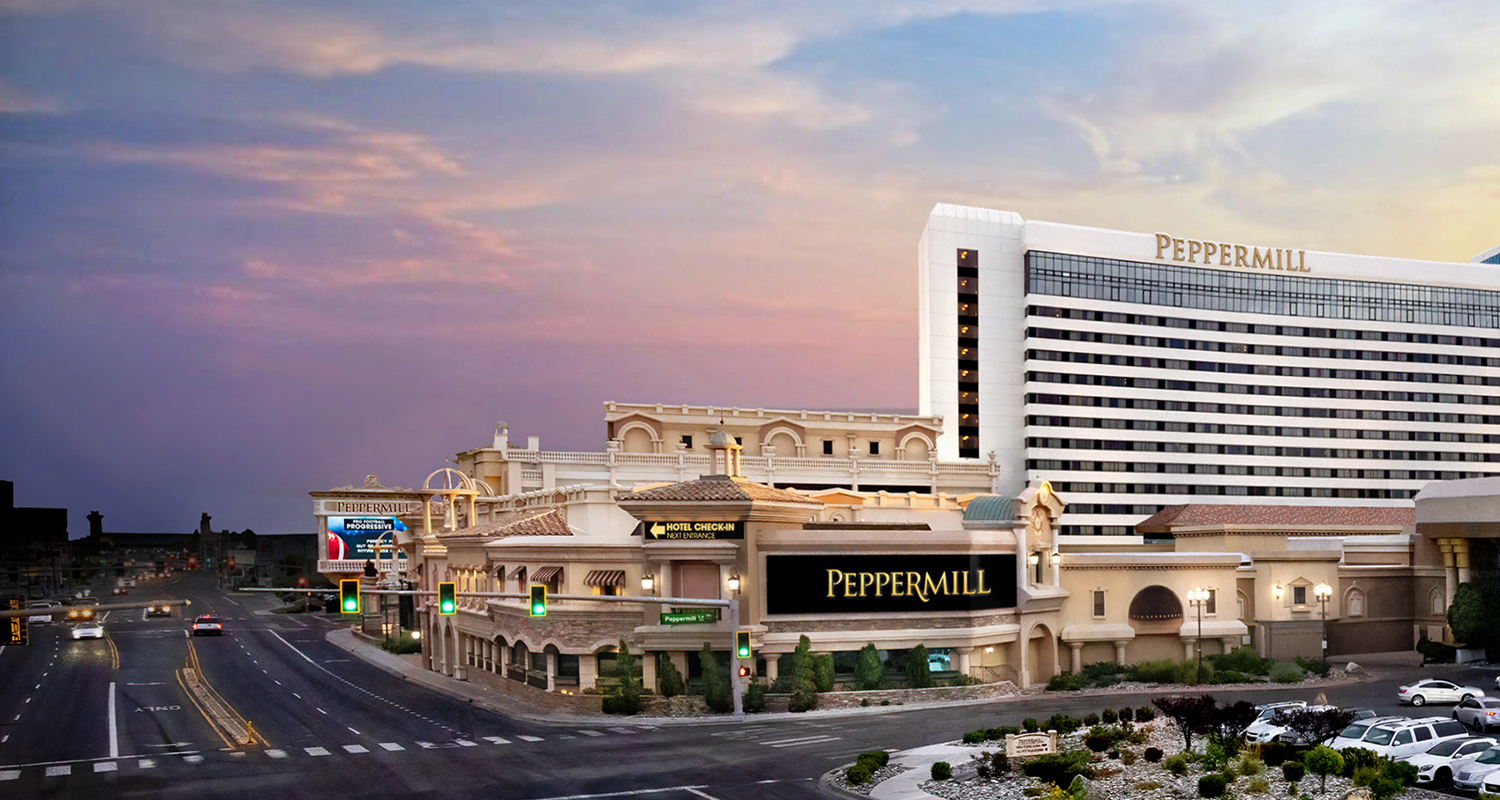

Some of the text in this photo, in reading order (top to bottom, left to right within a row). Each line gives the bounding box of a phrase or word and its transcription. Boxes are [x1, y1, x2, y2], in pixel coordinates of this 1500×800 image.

[1155, 233, 1311, 272] PEPPERMILL
[337, 501, 411, 515] PEPPERMILL
[666, 522, 735, 531] HOTEL CHECK-IN
[826, 568, 992, 603] PEPPERMILL
[664, 614, 697, 623] Peppermill
[134, 705, 181, 713] ONLY
